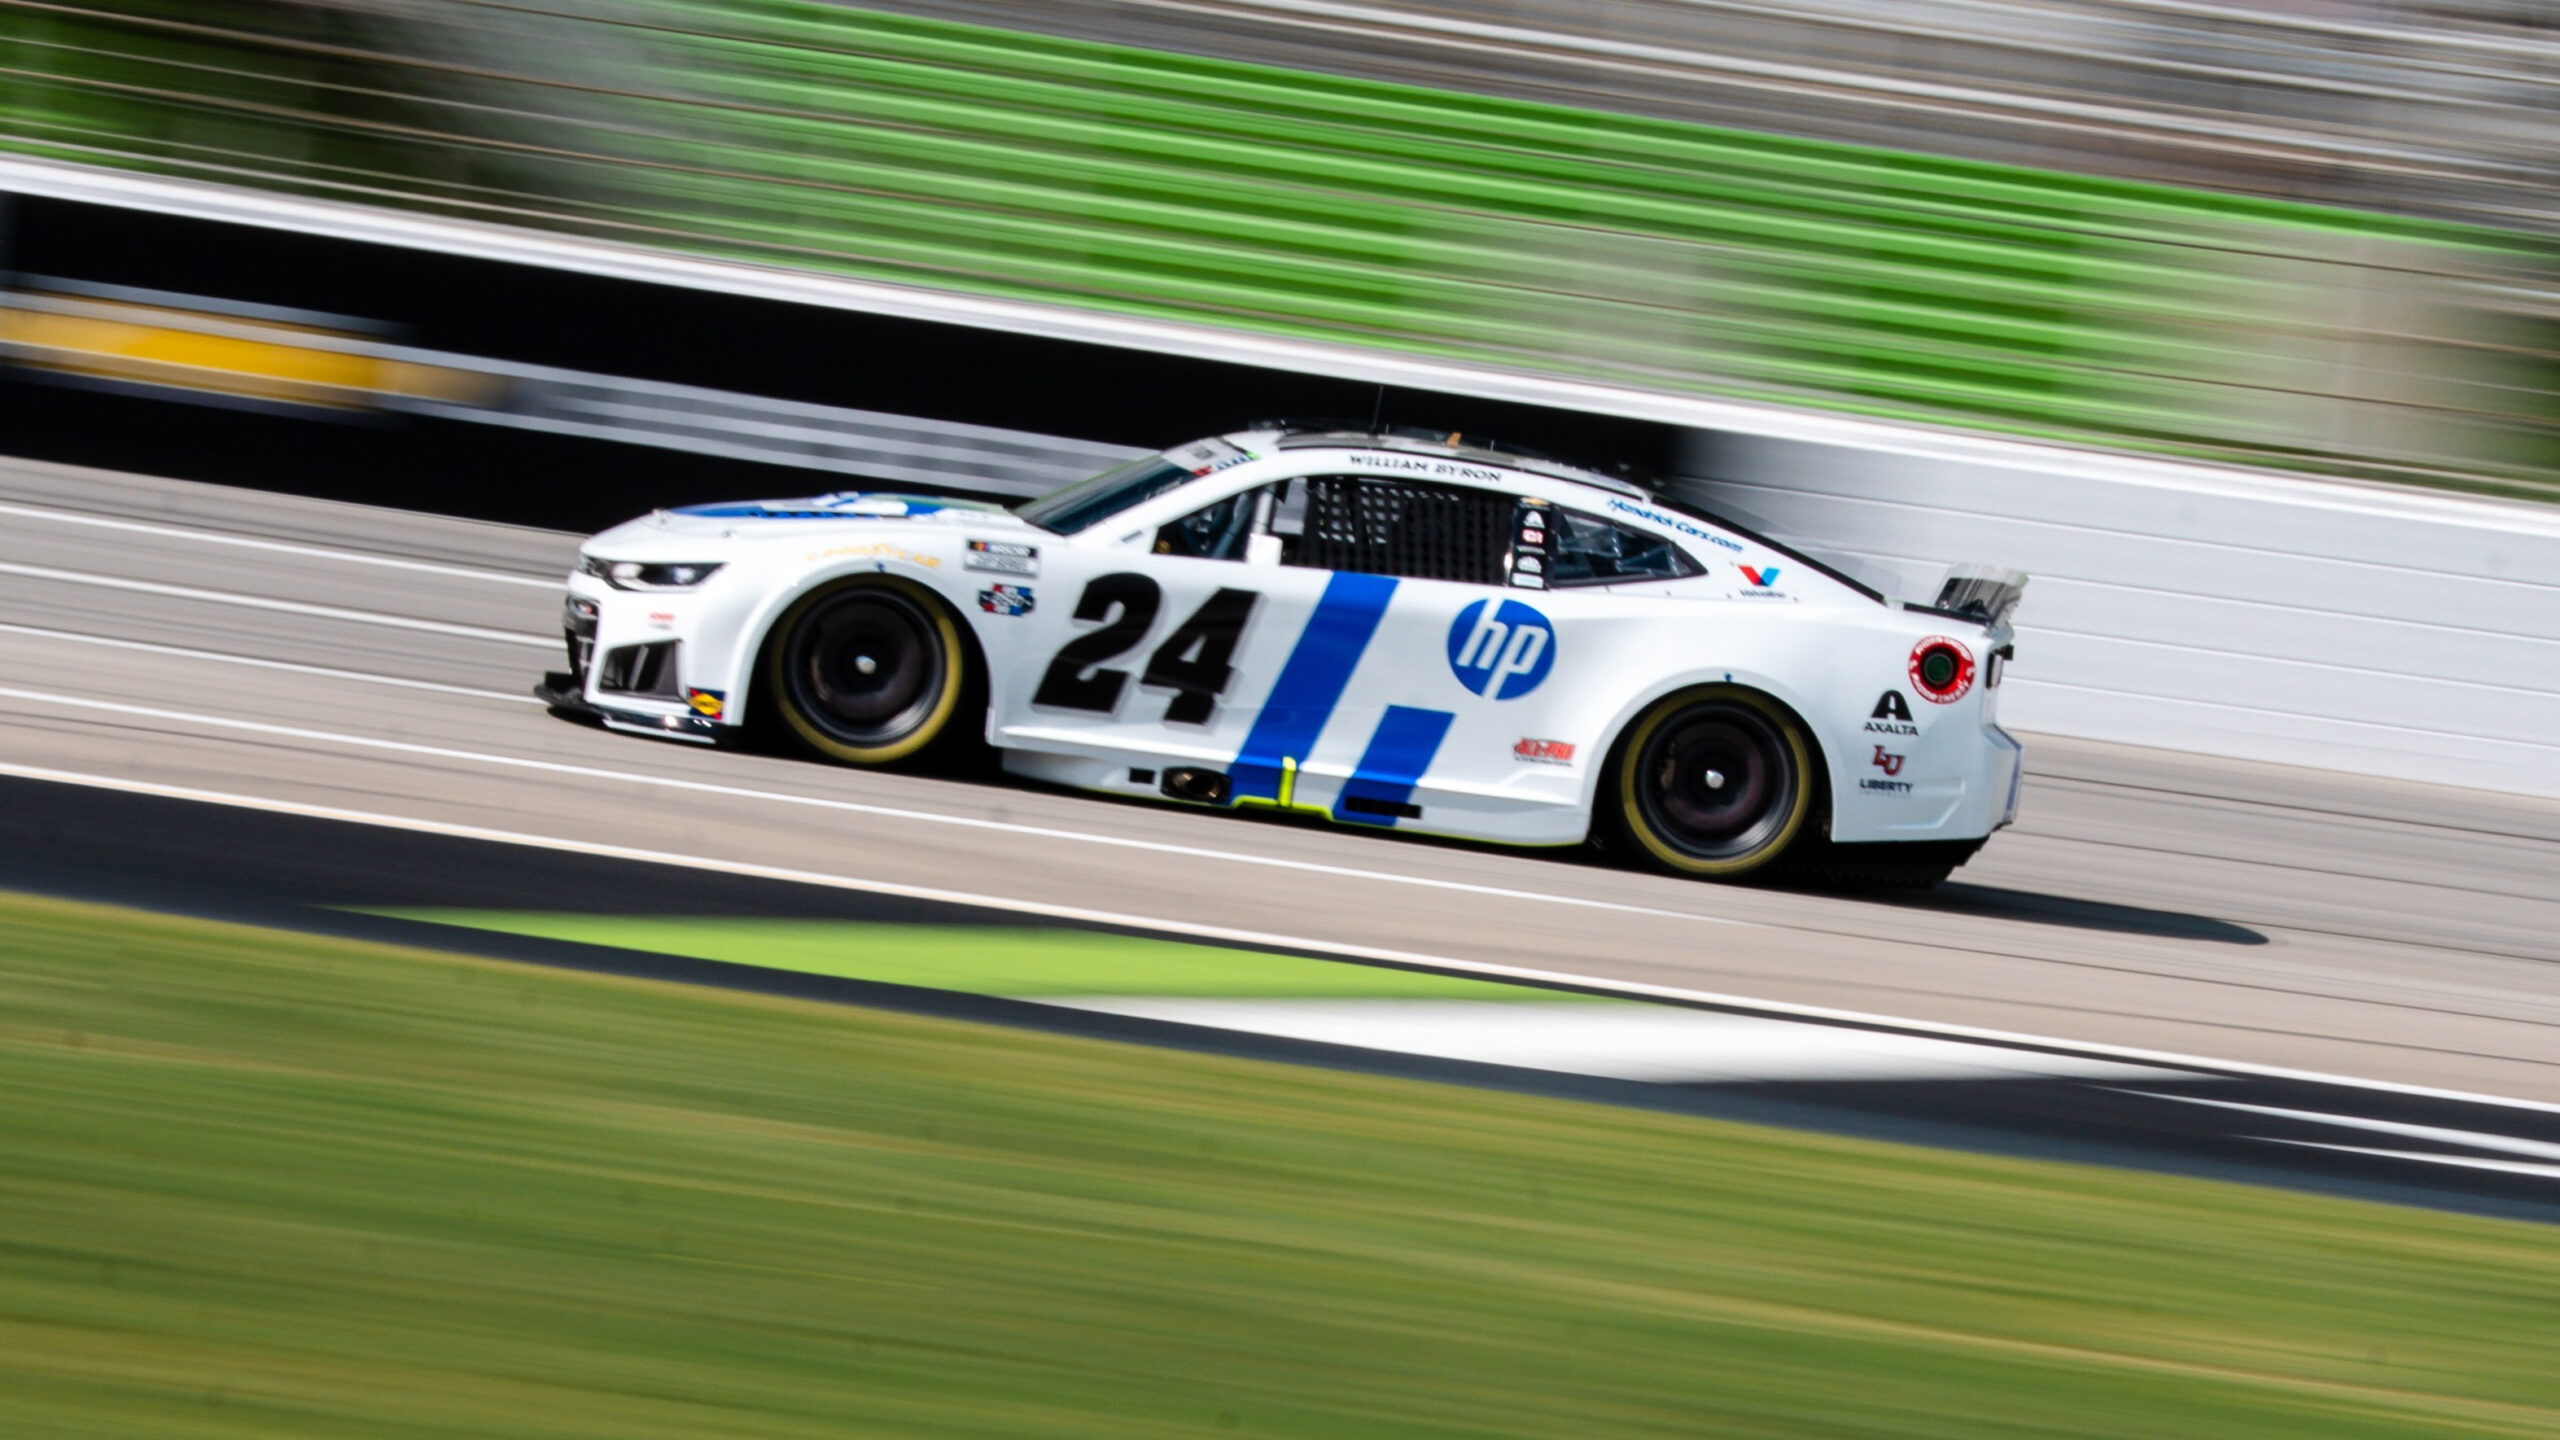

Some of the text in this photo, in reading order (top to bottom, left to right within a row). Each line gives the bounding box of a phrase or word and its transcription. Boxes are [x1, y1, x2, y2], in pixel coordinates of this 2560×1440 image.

[1350, 454, 1503, 483] WILLIAM BYRON
[1031, 572, 1263, 728] 24
[1455, 598, 1549, 700] hp
[1864, 722, 1919, 736] AXALTA
[1859, 778, 1914, 793] LIBERTY
